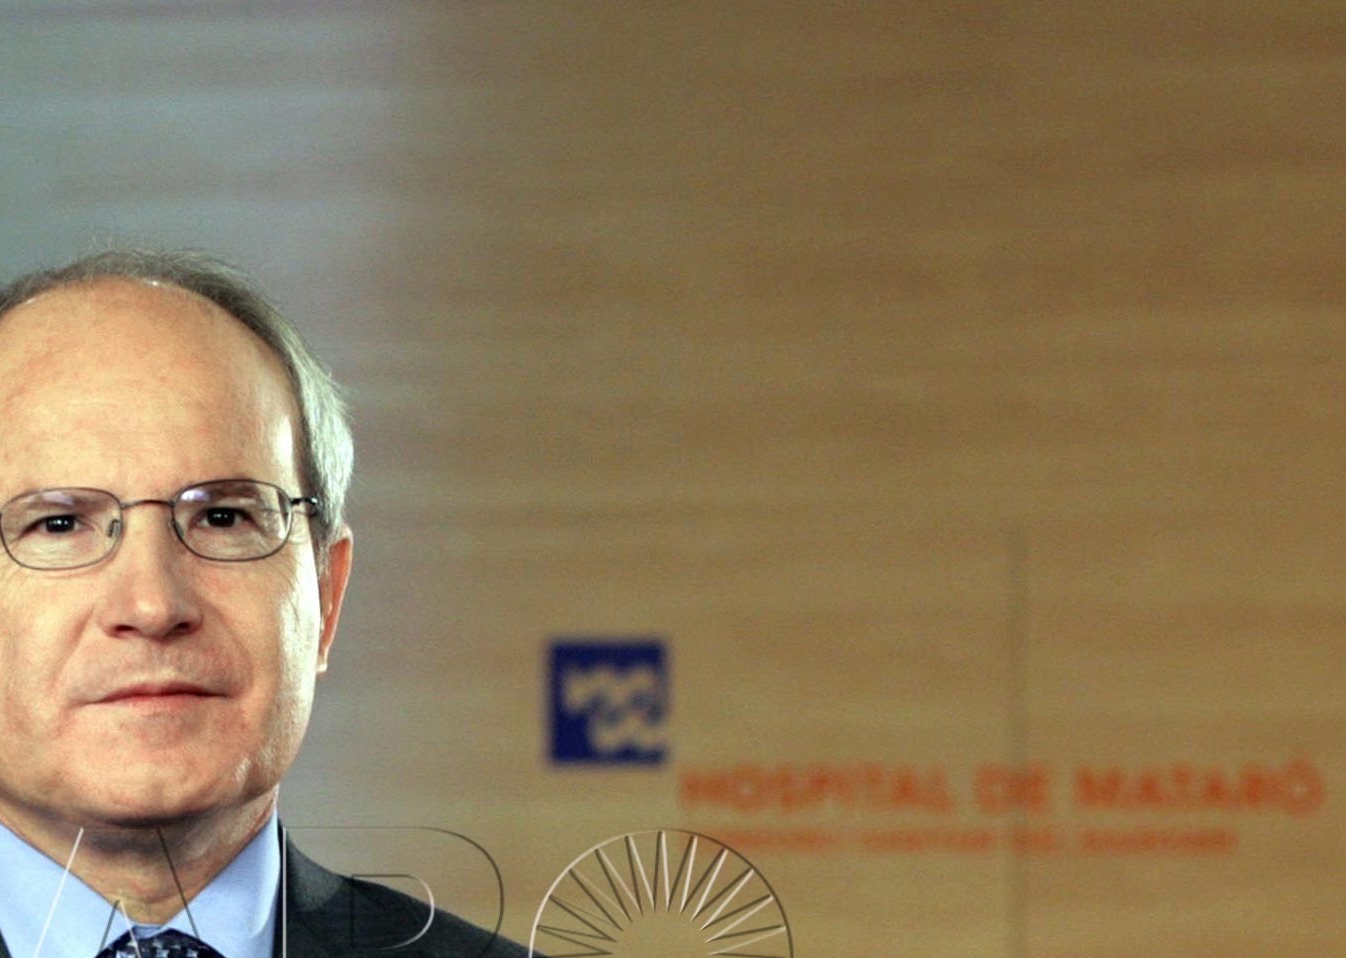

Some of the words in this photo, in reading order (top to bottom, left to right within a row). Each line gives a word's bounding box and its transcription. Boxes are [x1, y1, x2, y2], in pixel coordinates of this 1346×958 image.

[677, 765, 955, 814] HOSPITAL
[972, 763, 1052, 814] DE
[1072, 754, 1327, 818] MATARÓ
